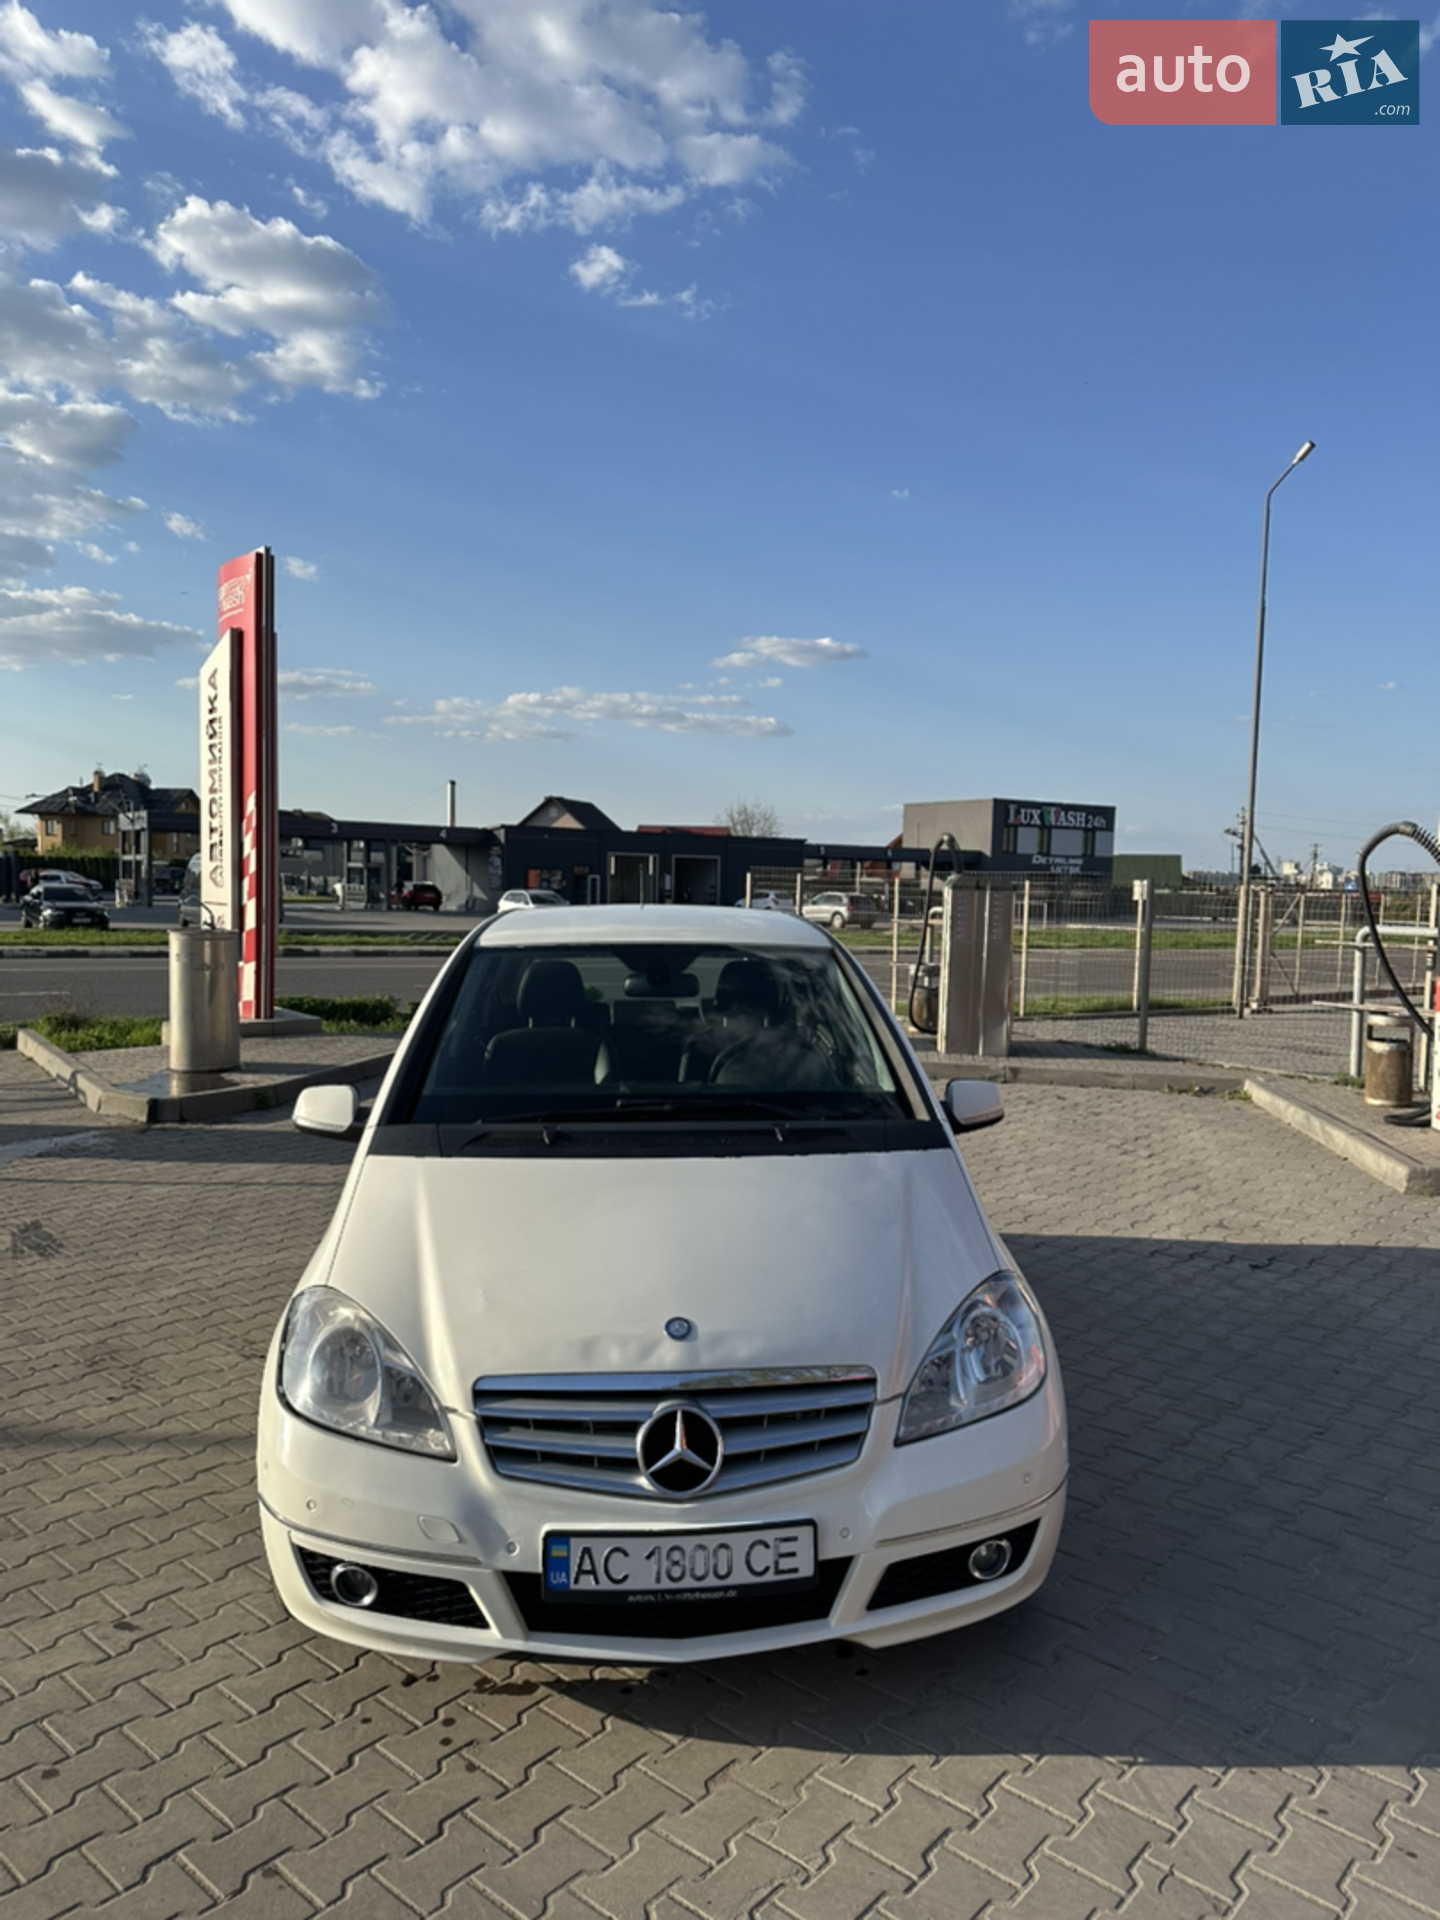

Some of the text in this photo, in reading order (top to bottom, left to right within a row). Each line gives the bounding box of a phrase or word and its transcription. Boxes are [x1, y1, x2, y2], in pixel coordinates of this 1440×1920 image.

[206, 667, 220, 888] АВТОМИЙКА
[330, 822, 338, 834] 3
[573, 1536, 799, 1586] AC 1800 CE
[550, 1571, 568, 1585] UA
